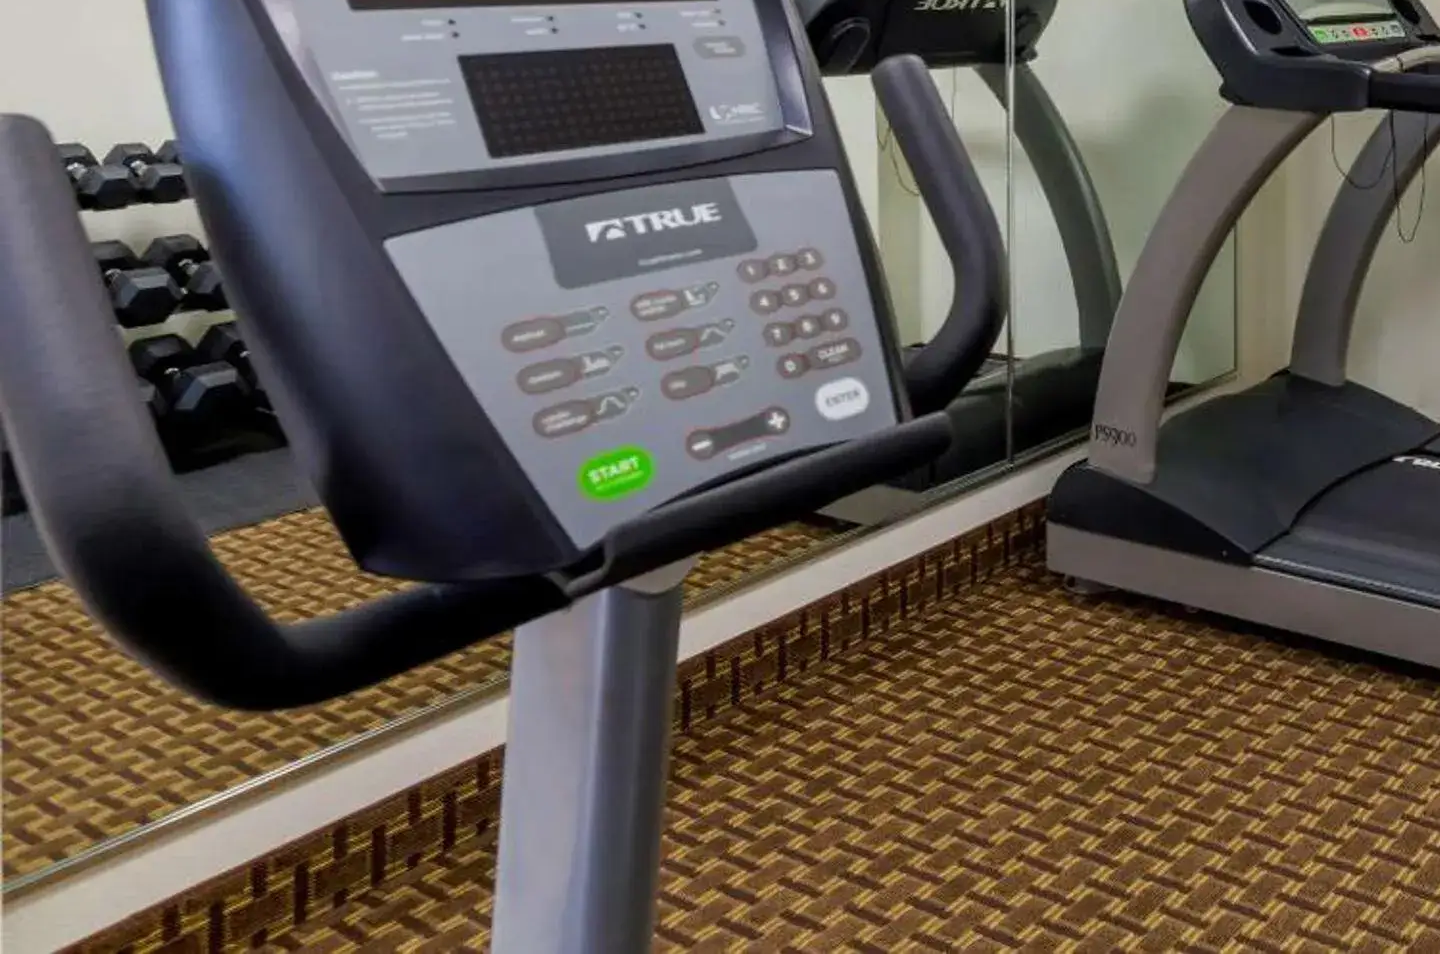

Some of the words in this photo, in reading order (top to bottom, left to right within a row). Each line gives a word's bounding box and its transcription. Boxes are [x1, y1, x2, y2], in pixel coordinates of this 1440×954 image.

[623, 202, 722, 235] TRUE
[825, 389, 860, 407] ENTER
[586, 454, 639, 485] START
